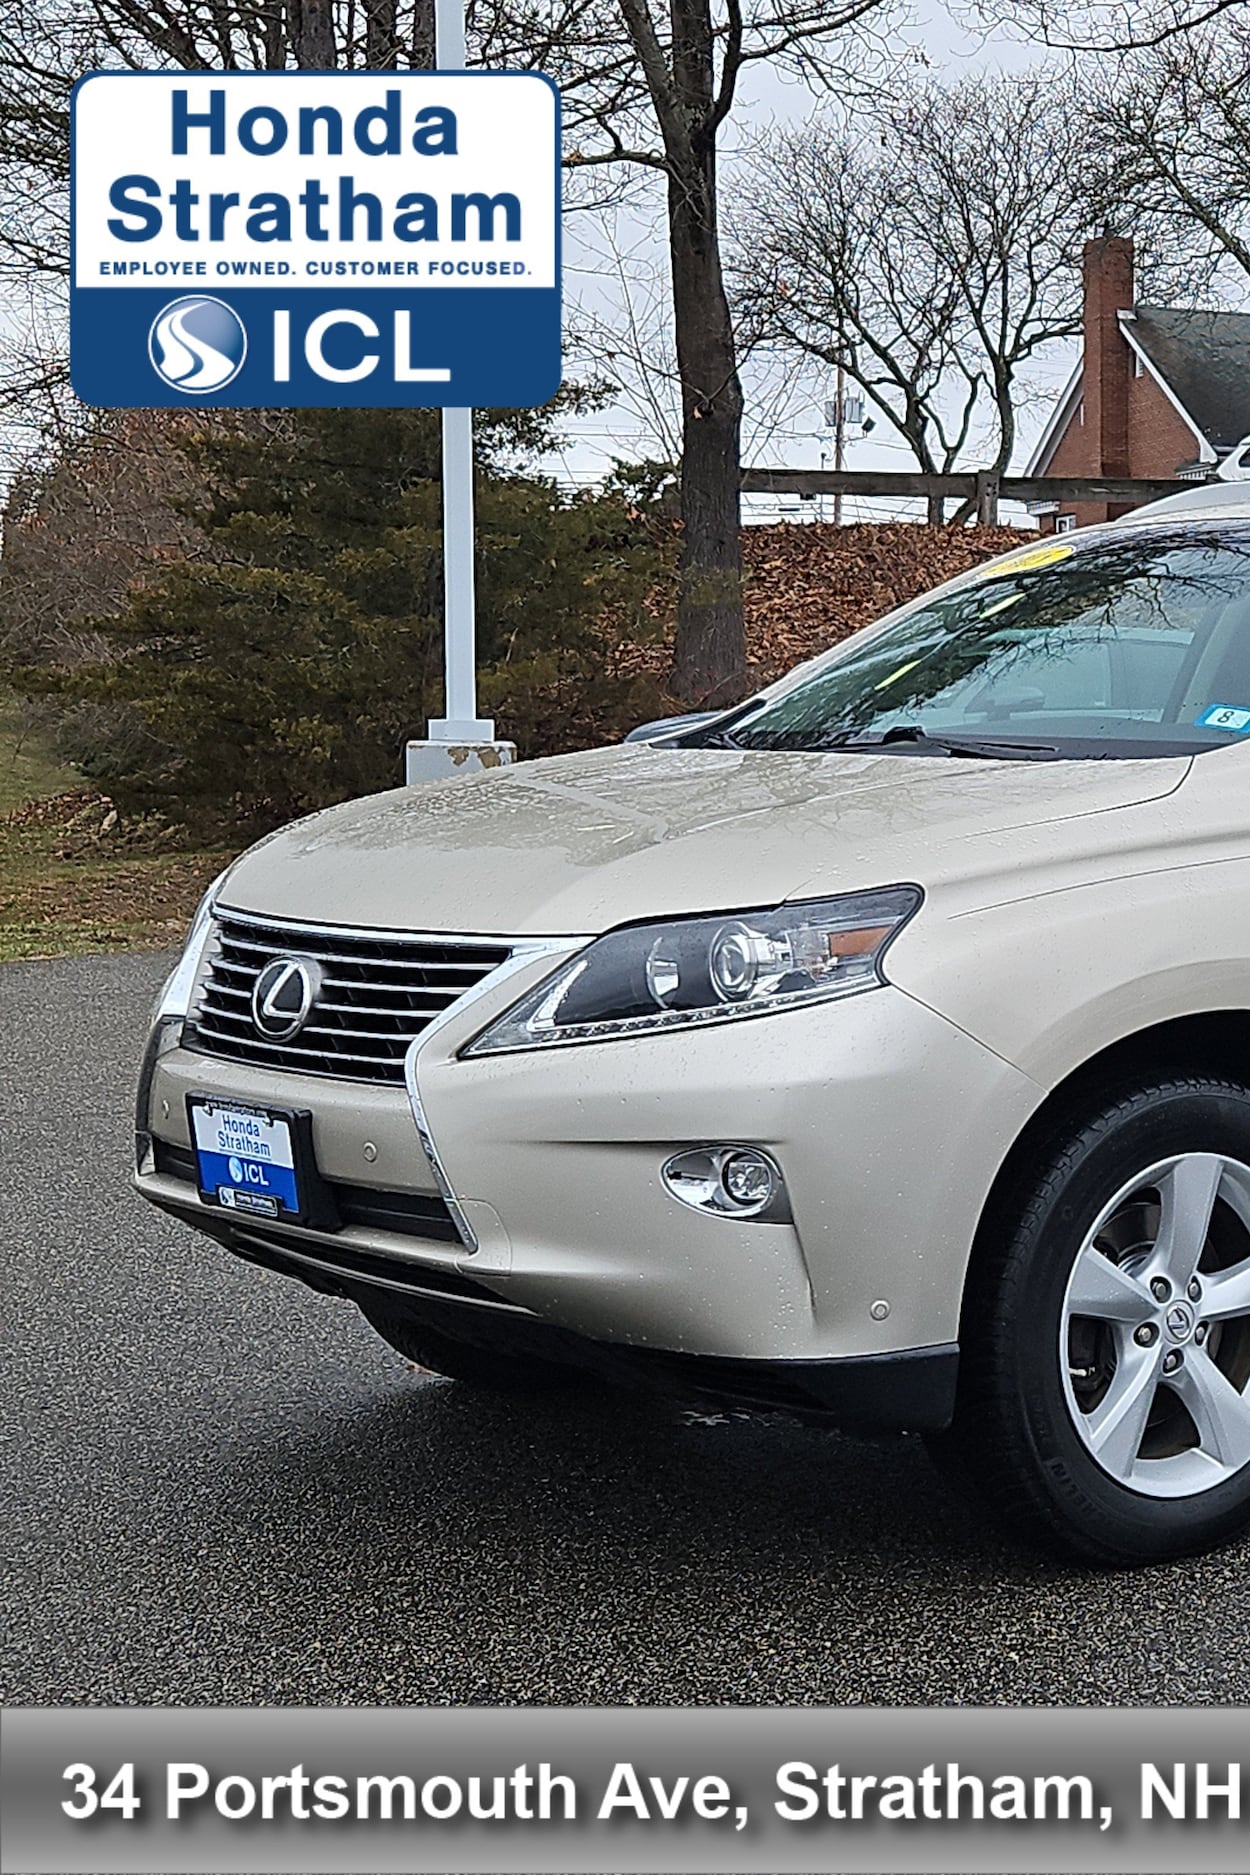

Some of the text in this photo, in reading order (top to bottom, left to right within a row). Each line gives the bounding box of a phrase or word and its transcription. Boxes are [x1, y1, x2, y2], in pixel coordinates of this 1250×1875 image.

[1217, 710, 1235, 723] 8
[221, 1113, 260, 1137] Honda
[217, 1130, 271, 1157] Stratham
[243, 1162, 270, 1186] ICL
